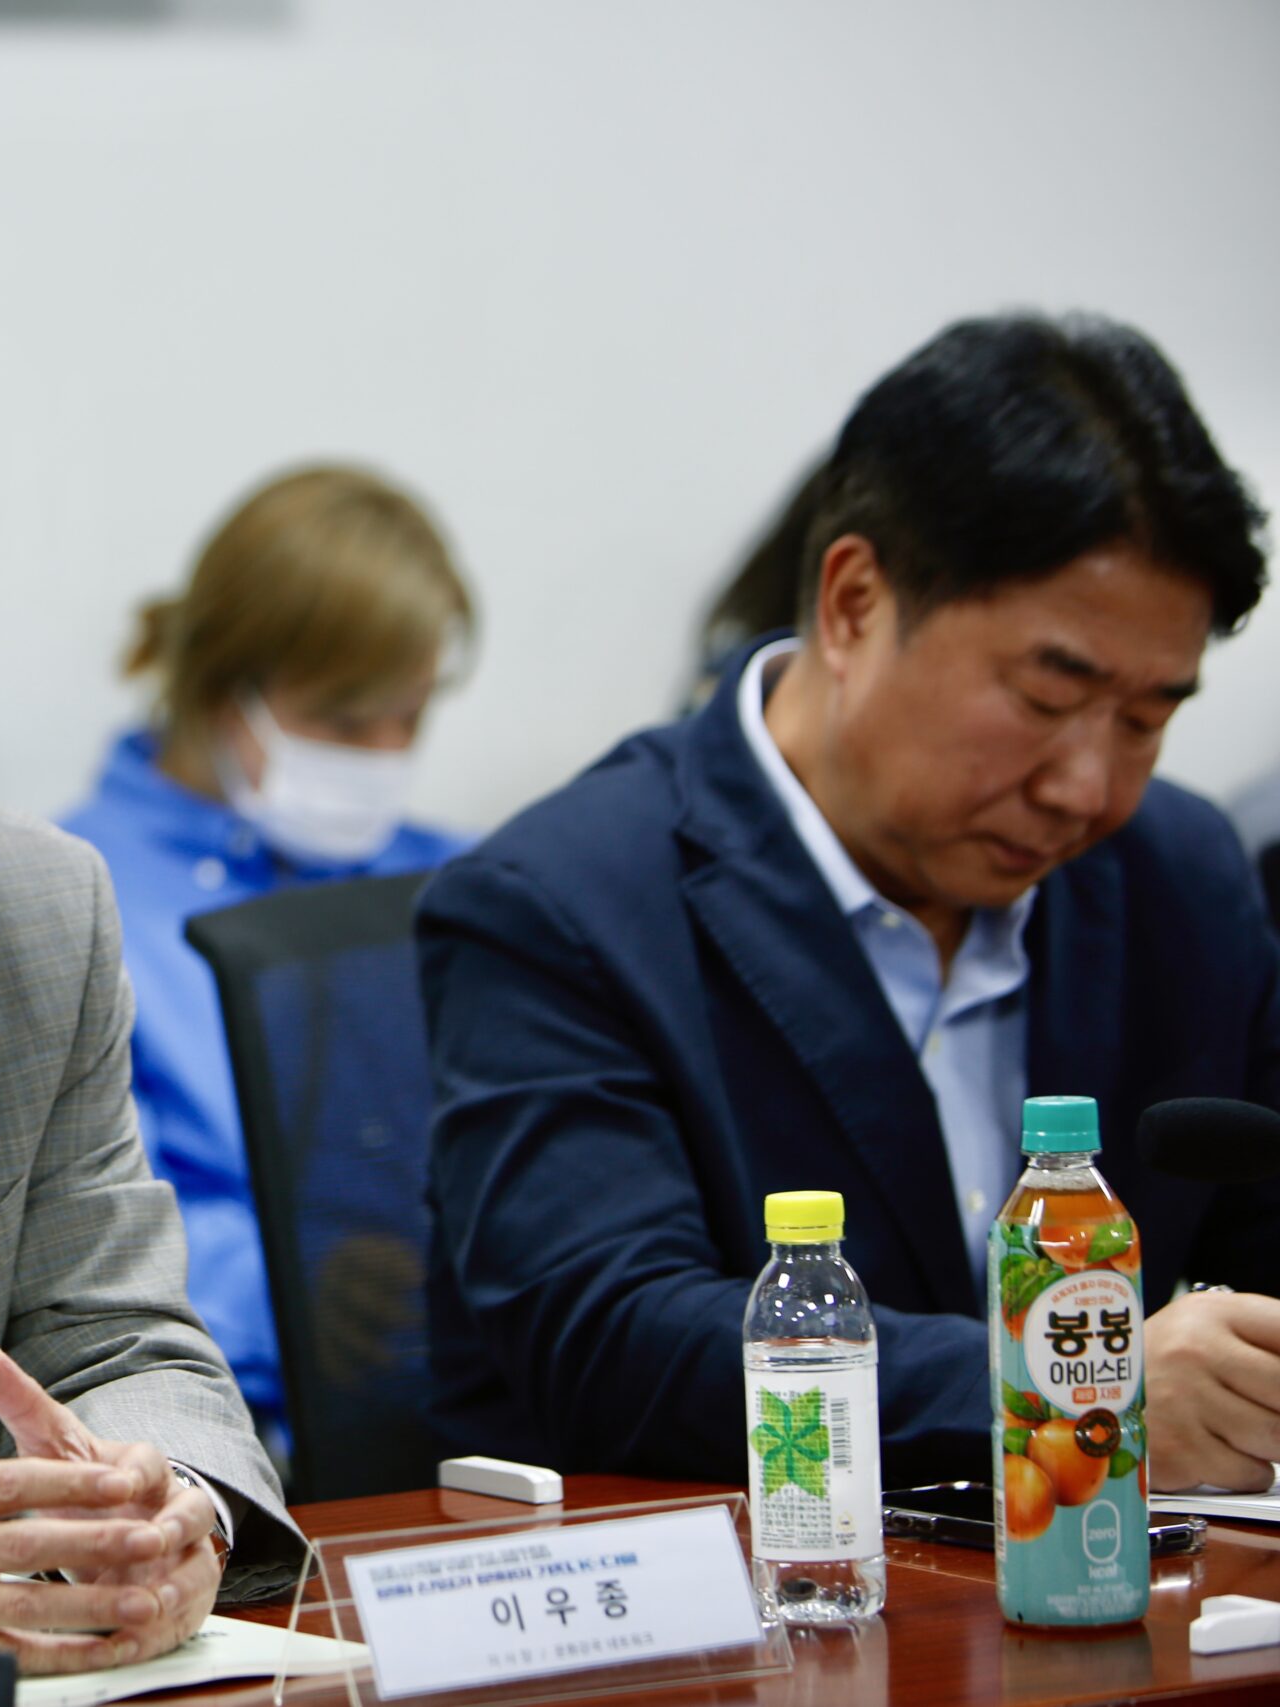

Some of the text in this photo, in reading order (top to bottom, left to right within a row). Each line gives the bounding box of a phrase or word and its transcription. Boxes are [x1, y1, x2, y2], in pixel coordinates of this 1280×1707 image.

[1043, 1305, 1132, 1358] 봉봉
[1049, 1357, 1132, 1385] 아이스티
[1087, 1527, 1117, 1541] zero
